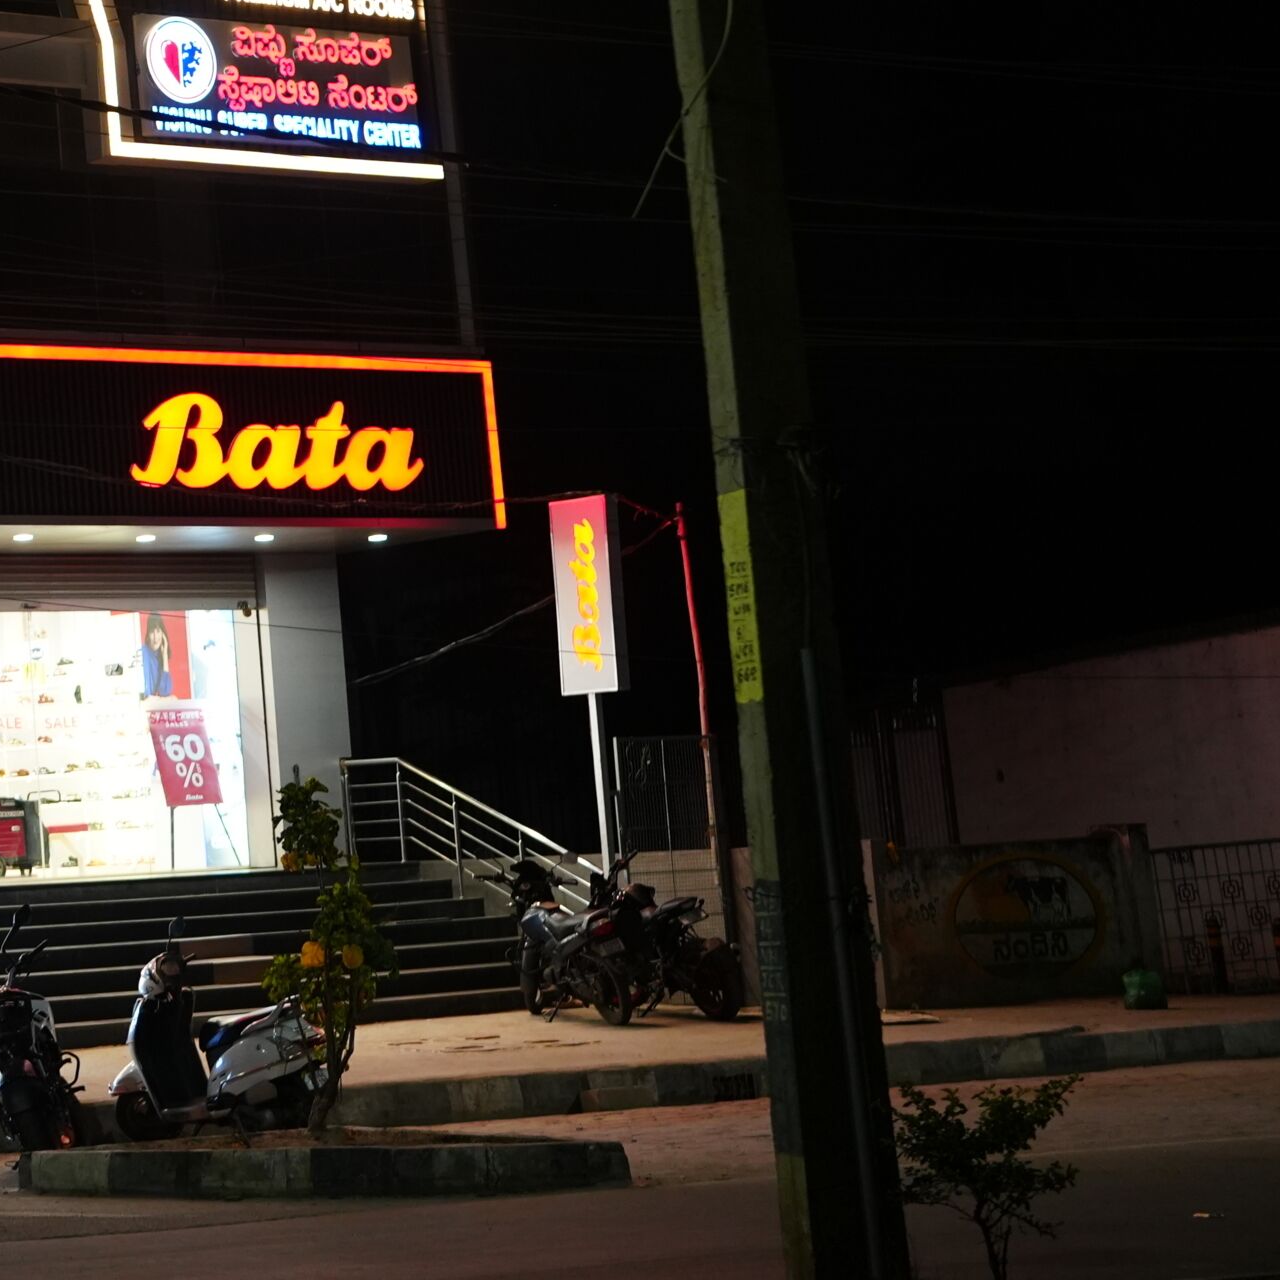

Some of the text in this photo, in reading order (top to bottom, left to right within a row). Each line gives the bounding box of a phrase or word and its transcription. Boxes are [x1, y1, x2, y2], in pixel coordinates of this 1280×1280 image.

[363, 120, 422, 149] CENTER
[130, 391, 424, 492] Bata
[570, 518, 600, 671] Bata
[44, 716, 80, 729] SALE
[165, 733, 205, 762] 60
[175, 762, 204, 788] %
[992, 931, 1070, 962] ನಂದಿನಿ
